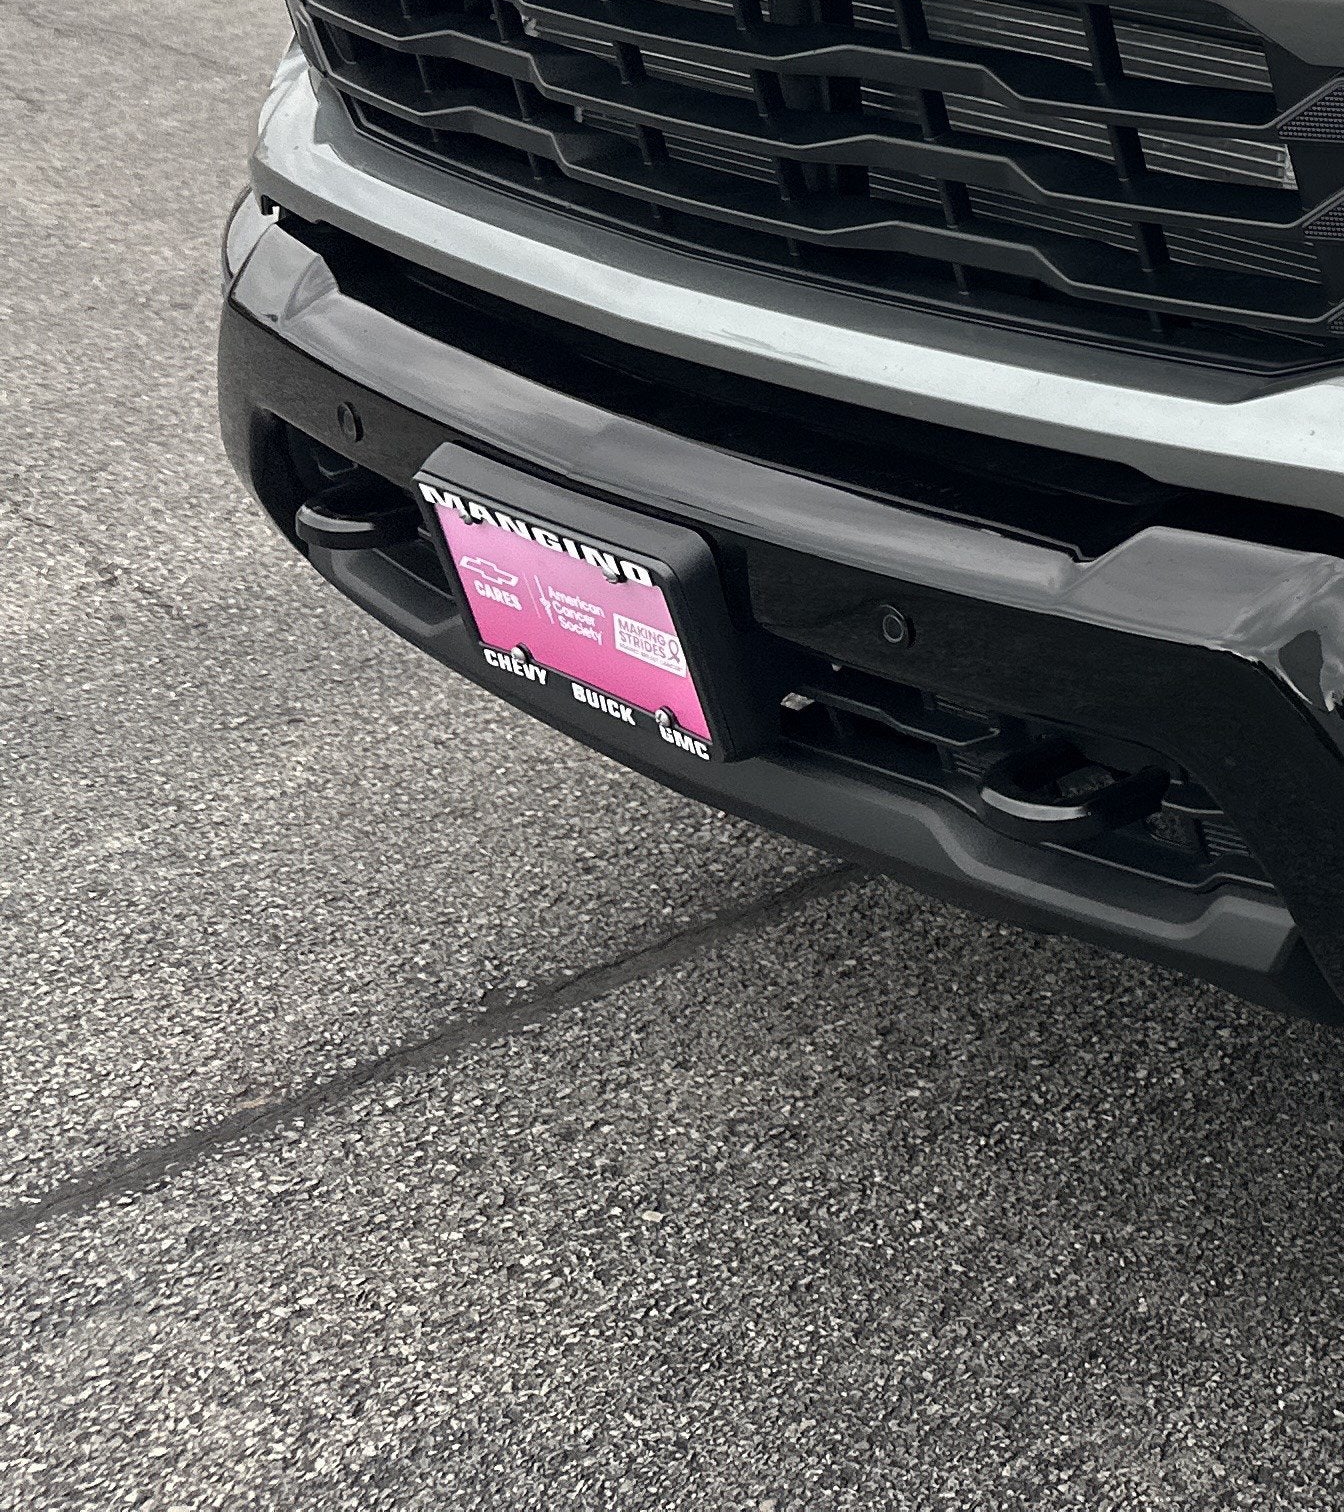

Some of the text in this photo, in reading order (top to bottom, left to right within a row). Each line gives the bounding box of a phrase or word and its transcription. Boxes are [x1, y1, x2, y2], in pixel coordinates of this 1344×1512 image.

[418, 483, 653, 587] MANGINO
[474, 579, 523, 611] CARES
[548, 585, 605, 619] American
[552, 600, 596, 627] Cancer
[558, 615, 602, 645] Society
[617, 617, 666, 647] MAKING
[619, 630, 666, 659] STRIDES
[483, 648, 710, 761] CHEVY BUICK GMC
